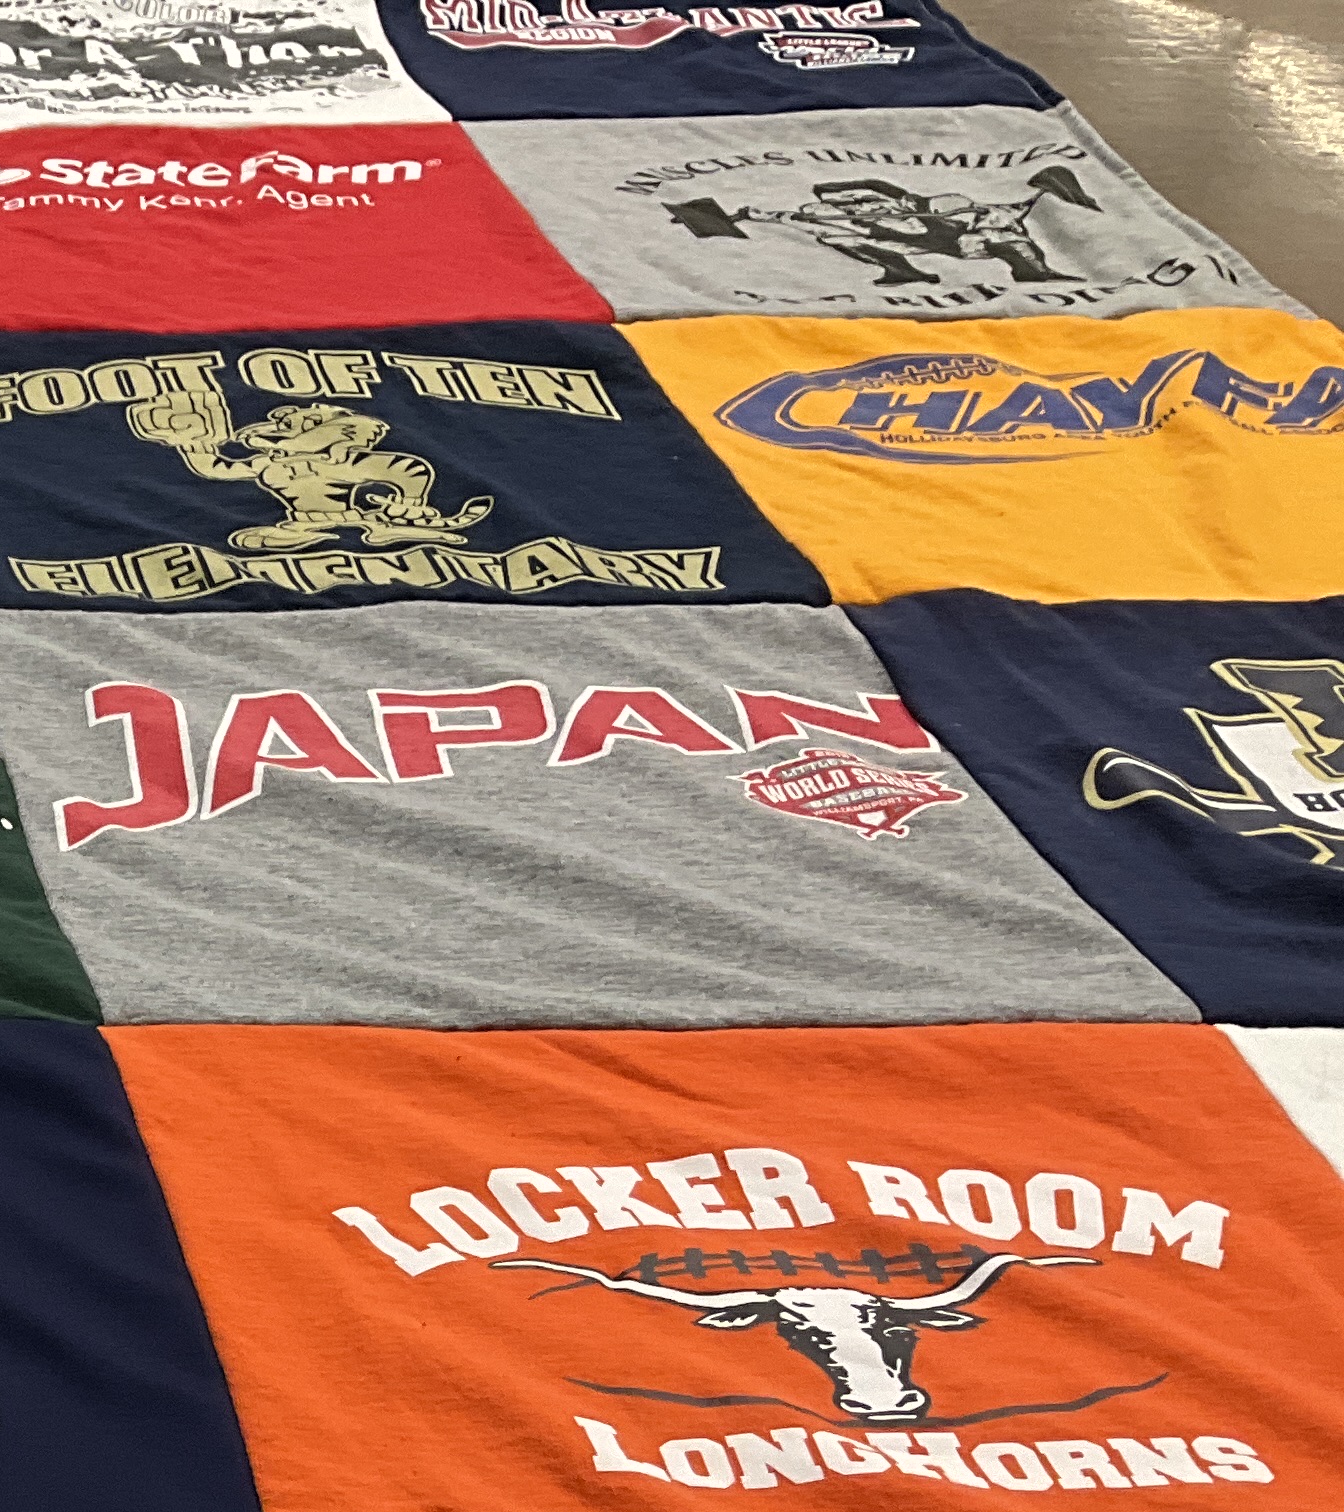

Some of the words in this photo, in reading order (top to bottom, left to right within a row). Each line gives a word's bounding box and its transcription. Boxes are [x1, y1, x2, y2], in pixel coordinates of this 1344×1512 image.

[256, 184, 375, 211] Agent
[613, 151, 795, 196] MUSCLES
[805, 142, 1089, 169] UNLIMITED
[243, 348, 382, 399] OF
[387, 352, 623, 422] TEN
[8, 537, 726, 600] ELEMENTARY
[53, 680, 943, 852] JAPAN
[758, 769, 852, 805] WORLD
[849, 767, 940, 798] SERIES
[331, 1146, 831, 1279] LOCKER
[843, 1158, 1231, 1271] ROOM
[570, 1413, 1277, 1493] LONGHORNS
